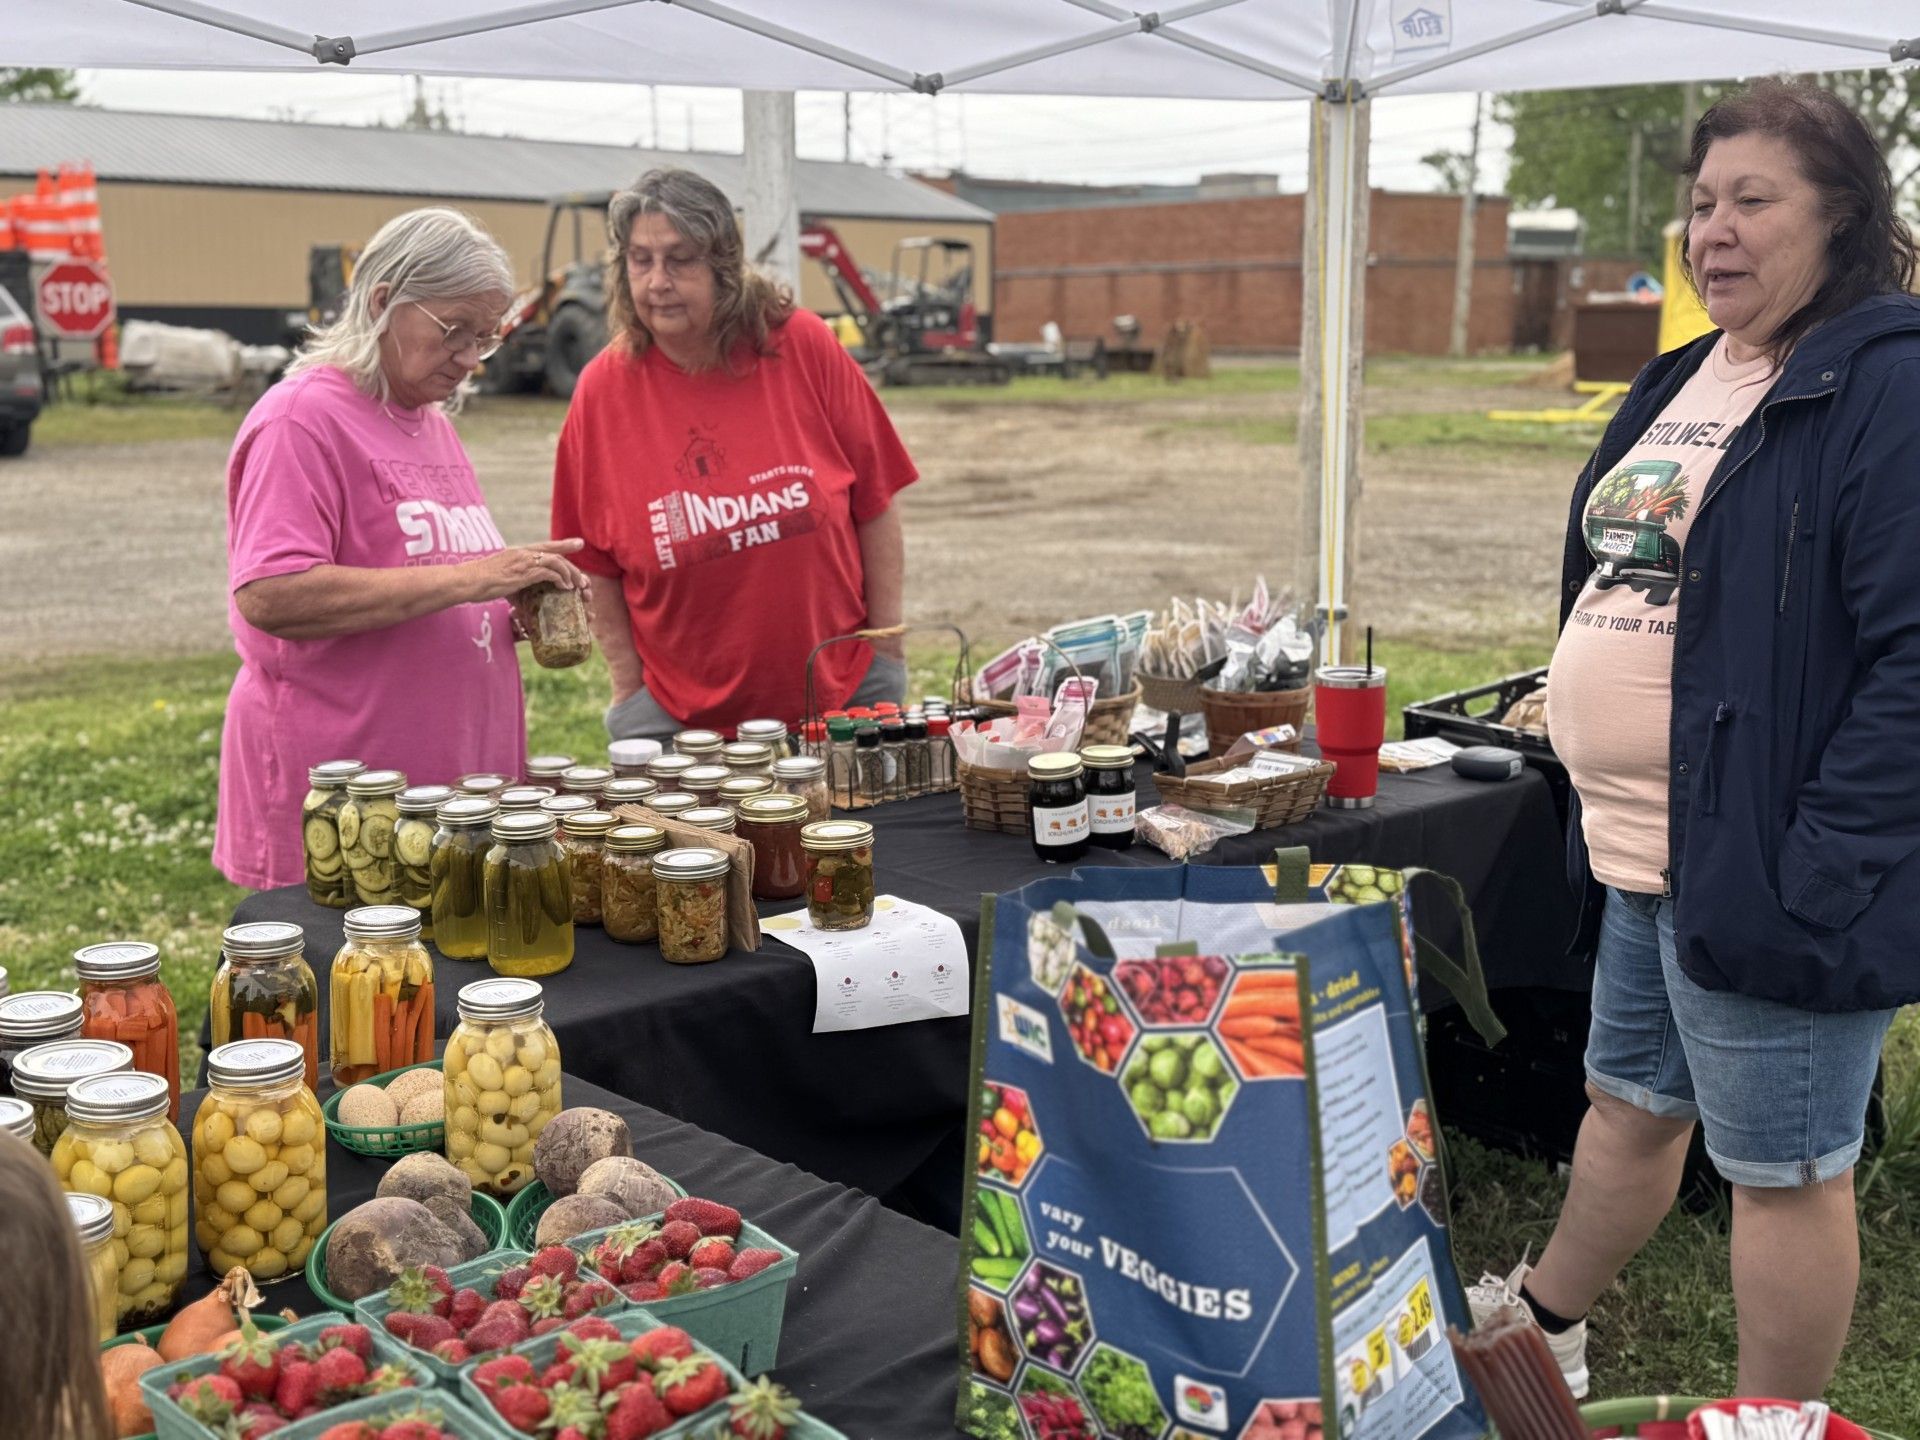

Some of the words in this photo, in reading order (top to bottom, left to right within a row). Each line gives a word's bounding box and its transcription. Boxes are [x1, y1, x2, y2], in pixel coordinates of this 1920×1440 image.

[43, 281, 110, 316] STOP
[748, 465, 787, 485] STARTS
[787, 464, 815, 478] HERE
[682, 481, 810, 536] INDIANS
[727, 520, 781, 553] FAN
[1593, 614, 1608, 629] TO
[1609, 616, 1643, 633] YOUR
[1039, 1201, 1085, 1233] vary
[1046, 1230, 1095, 1260] your
[1098, 1235, 1253, 1321] VEGGIES
